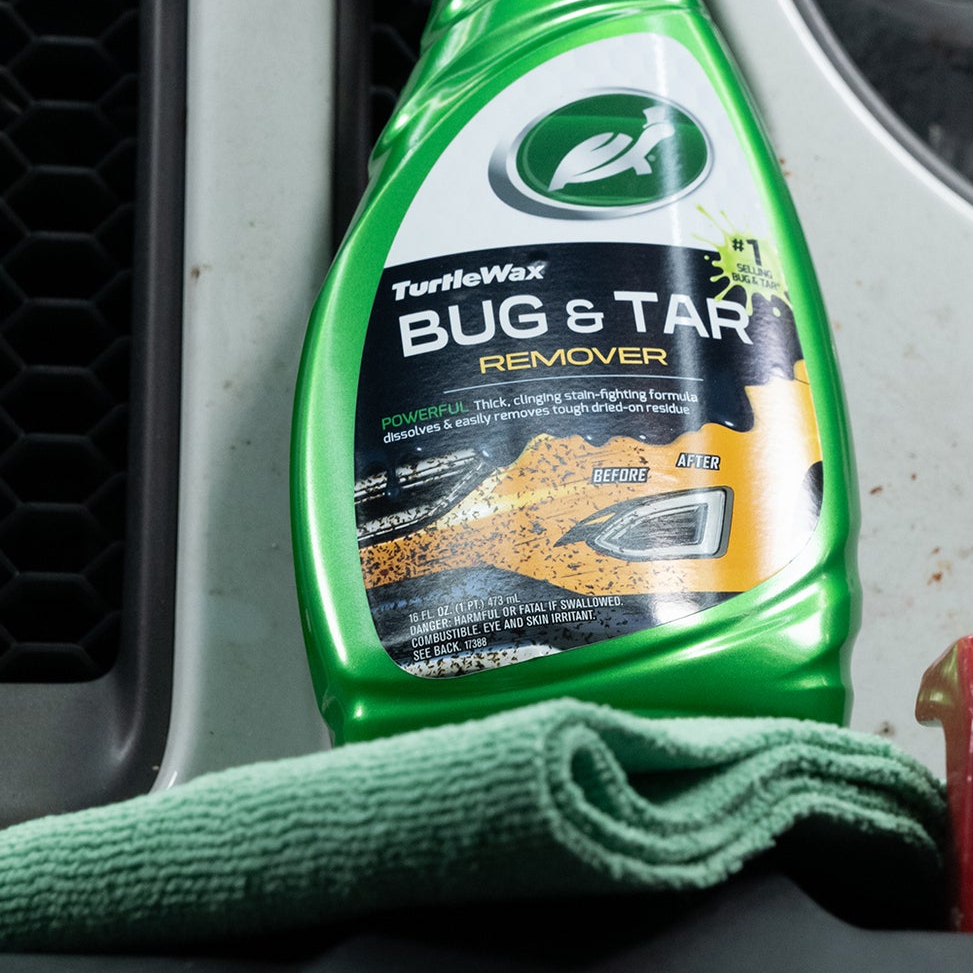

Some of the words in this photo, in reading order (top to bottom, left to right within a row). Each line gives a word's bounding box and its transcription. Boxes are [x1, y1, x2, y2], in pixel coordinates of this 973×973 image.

[732, 238, 762, 266] #1
[731, 272, 751, 284] BUG
[752, 276, 759, 284] &
[736, 263, 773, 279] SELLING
[399, 294, 548, 358] BUG
[566, 299, 604, 333] &
[613, 291, 753, 345] TAR
[479, 346, 668, 374] REMOVER
[381, 401, 469, 430] POWERFUL
[474, 397, 511, 411] Thick,
[514, 393, 562, 406] clinging
[564, 388, 647, 402] stain-fighting
[649, 389, 698, 403] formula
[383, 423, 441, 443] dissolves
[443, 420, 453, 430] &
[455, 412, 492, 428] easily
[494, 406, 549, 421] removes
[553, 403, 589, 416] tough
[591, 402, 643, 413] dried-on
[646, 403, 690, 414] residue
[593, 468, 648, 483] BEFORE
[677, 454, 719, 469] AFTER
[409, 612, 419, 623] 16
[421, 609, 435, 621] FL.
[437, 606, 452, 617] OZ.
[455, 602, 463, 614] (1
[487, 595, 504, 607] 473
[506, 593, 520, 604] mL
[410, 618, 451, 635] DANGER:
[454, 609, 500, 626] HARMFUL
[502, 606, 517, 617] OR
[520, 602, 546, 615] FATAL
[548, 600, 557, 611] IF
[560, 596, 624, 610] SWALLOWED.
[411, 624, 481, 648] COMBUSTIBLE.
[484, 621, 501, 633] EYE
[504, 617, 523, 630] AND
[526, 614, 549, 626] SKIN
[551, 610, 596, 623] IRRITANT.
[413, 648, 432, 661] SEE
[434, 641, 462, 656] BACK.
[464, 637, 487, 650] 17388
